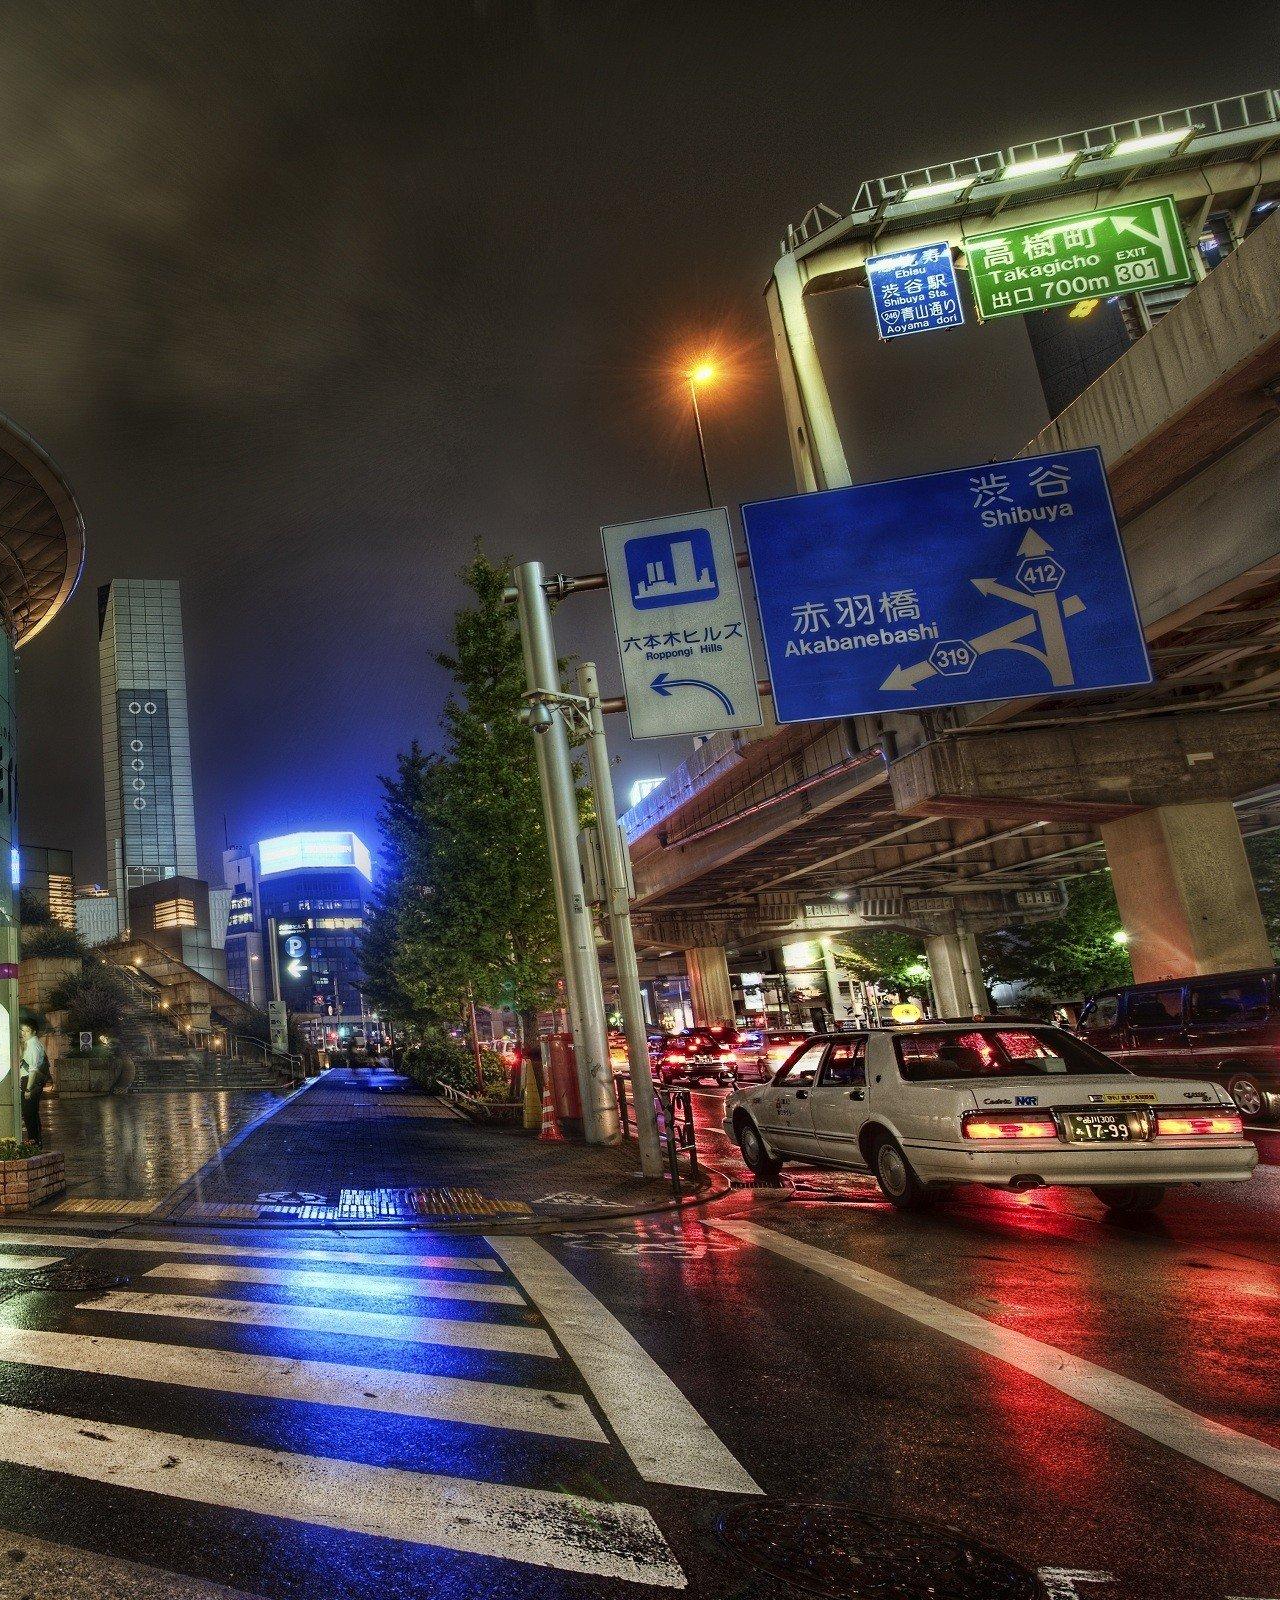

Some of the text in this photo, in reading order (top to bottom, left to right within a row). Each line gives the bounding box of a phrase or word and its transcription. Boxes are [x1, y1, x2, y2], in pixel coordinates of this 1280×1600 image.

[982, 225, 1098, 269] 高樹町
[1116, 246, 1148, 260] EXIT
[895, 267, 927, 279] Ebisu
[987, 254, 1101, 285] Takagicho
[1117, 260, 1158, 283] 301
[881, 273, 948, 299] 渋谷駅
[991, 275, 1110, 309] 出口 700m
[884, 289, 949, 308] Shibuya Sta.
[884, 299, 956, 321] 246 青山通り
[886, 313, 958, 334] Aoyama dori
[970, 464, 1072, 510] 渋谷
[981, 501, 1074, 529] Shibuya
[1023, 564, 1057, 585] 412
[791, 588, 921, 636] 赤羽橋
[622, 621, 743, 653] 六本木ヒルズ
[784, 621, 939, 658] Akabanebashi
[645, 643, 723, 661] Roppongi Hills
[937, 648, 970, 669] 319
[1084, 1123, 1129, 1139] 17-99
